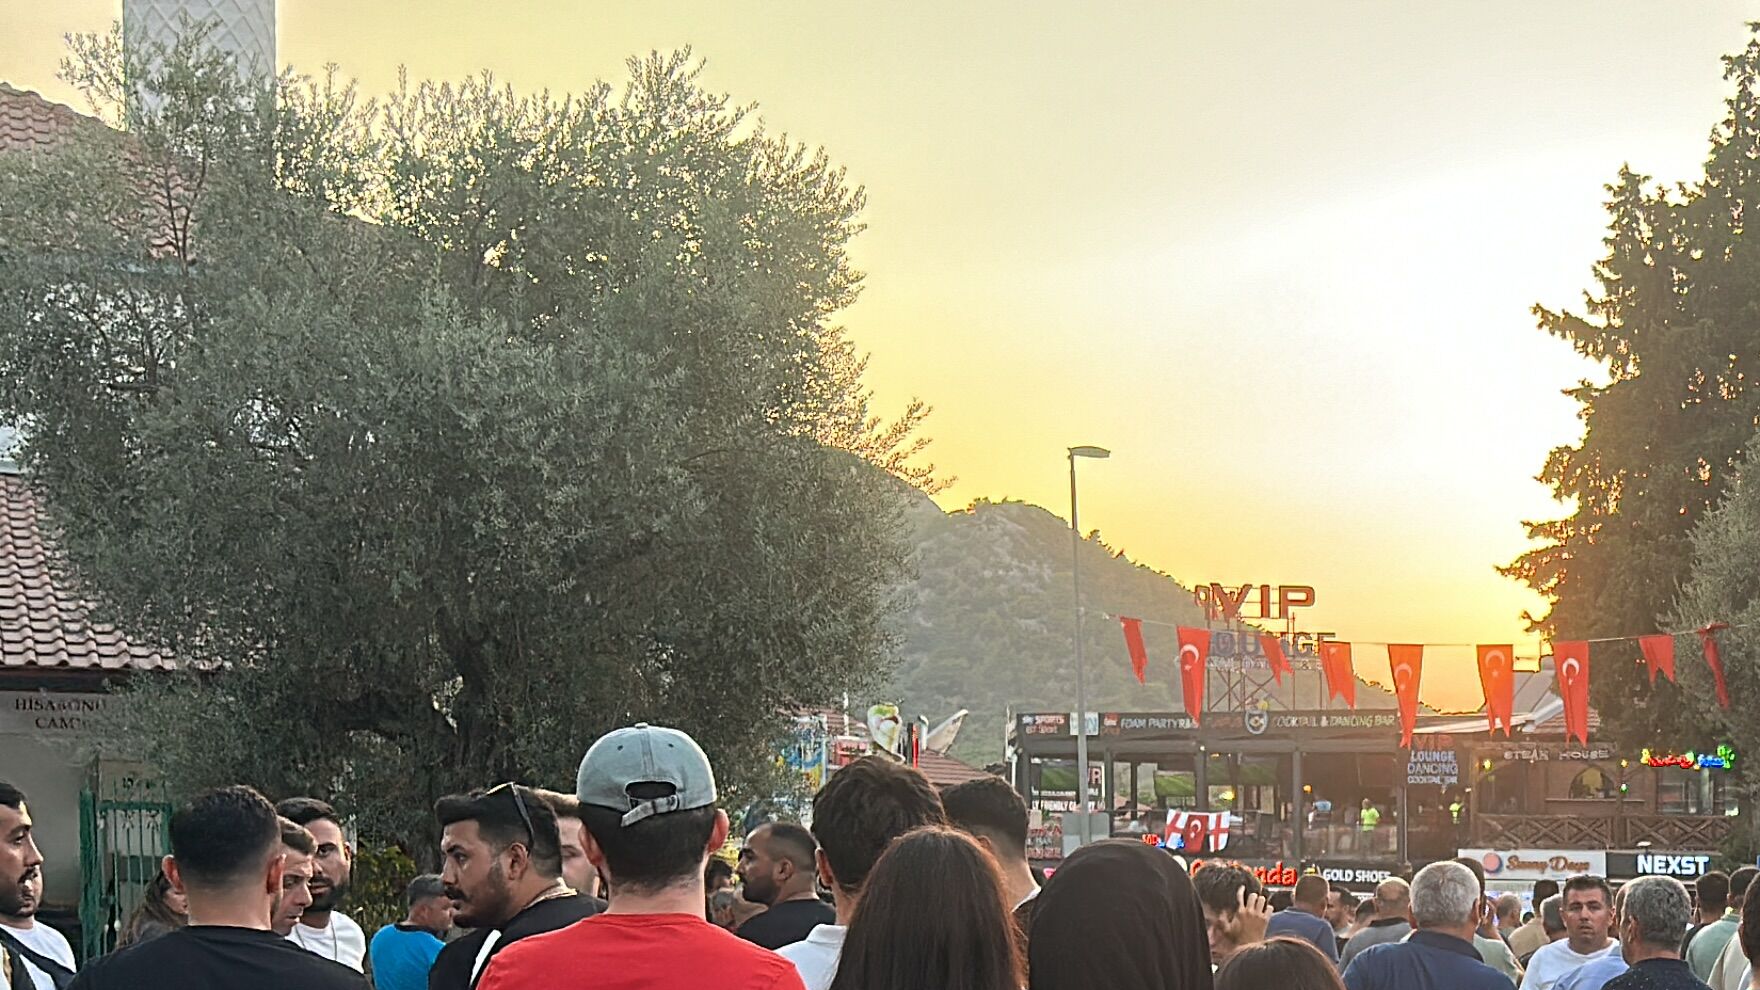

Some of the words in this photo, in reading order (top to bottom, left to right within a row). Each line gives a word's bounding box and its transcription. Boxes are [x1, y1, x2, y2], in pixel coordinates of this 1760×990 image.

[1209, 582, 1316, 622] VIP
[1374, 714, 1396, 727] BAR
[1410, 750, 1457, 762] LOUNGE
[1407, 762, 1459, 775] DANCING
[1637, 855, 1710, 875] NEXST
[1322, 868, 1354, 882] GOLD
